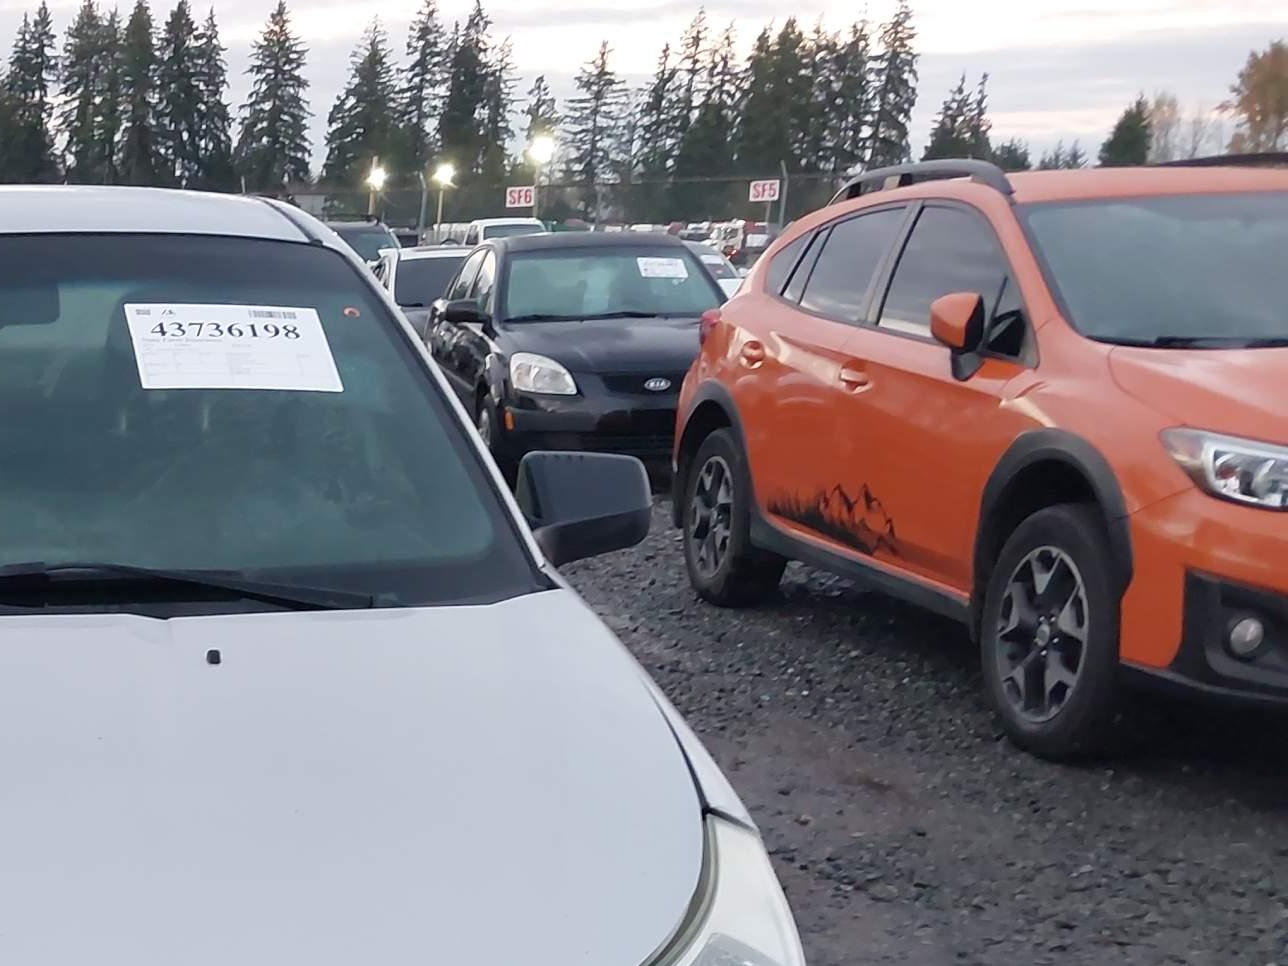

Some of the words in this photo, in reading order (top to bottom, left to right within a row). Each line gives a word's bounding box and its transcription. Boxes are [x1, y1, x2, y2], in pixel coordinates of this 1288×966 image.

[508, 188, 532, 205] SF6
[752, 182, 777, 199] SF5
[150, 321, 301, 339] 43736198
